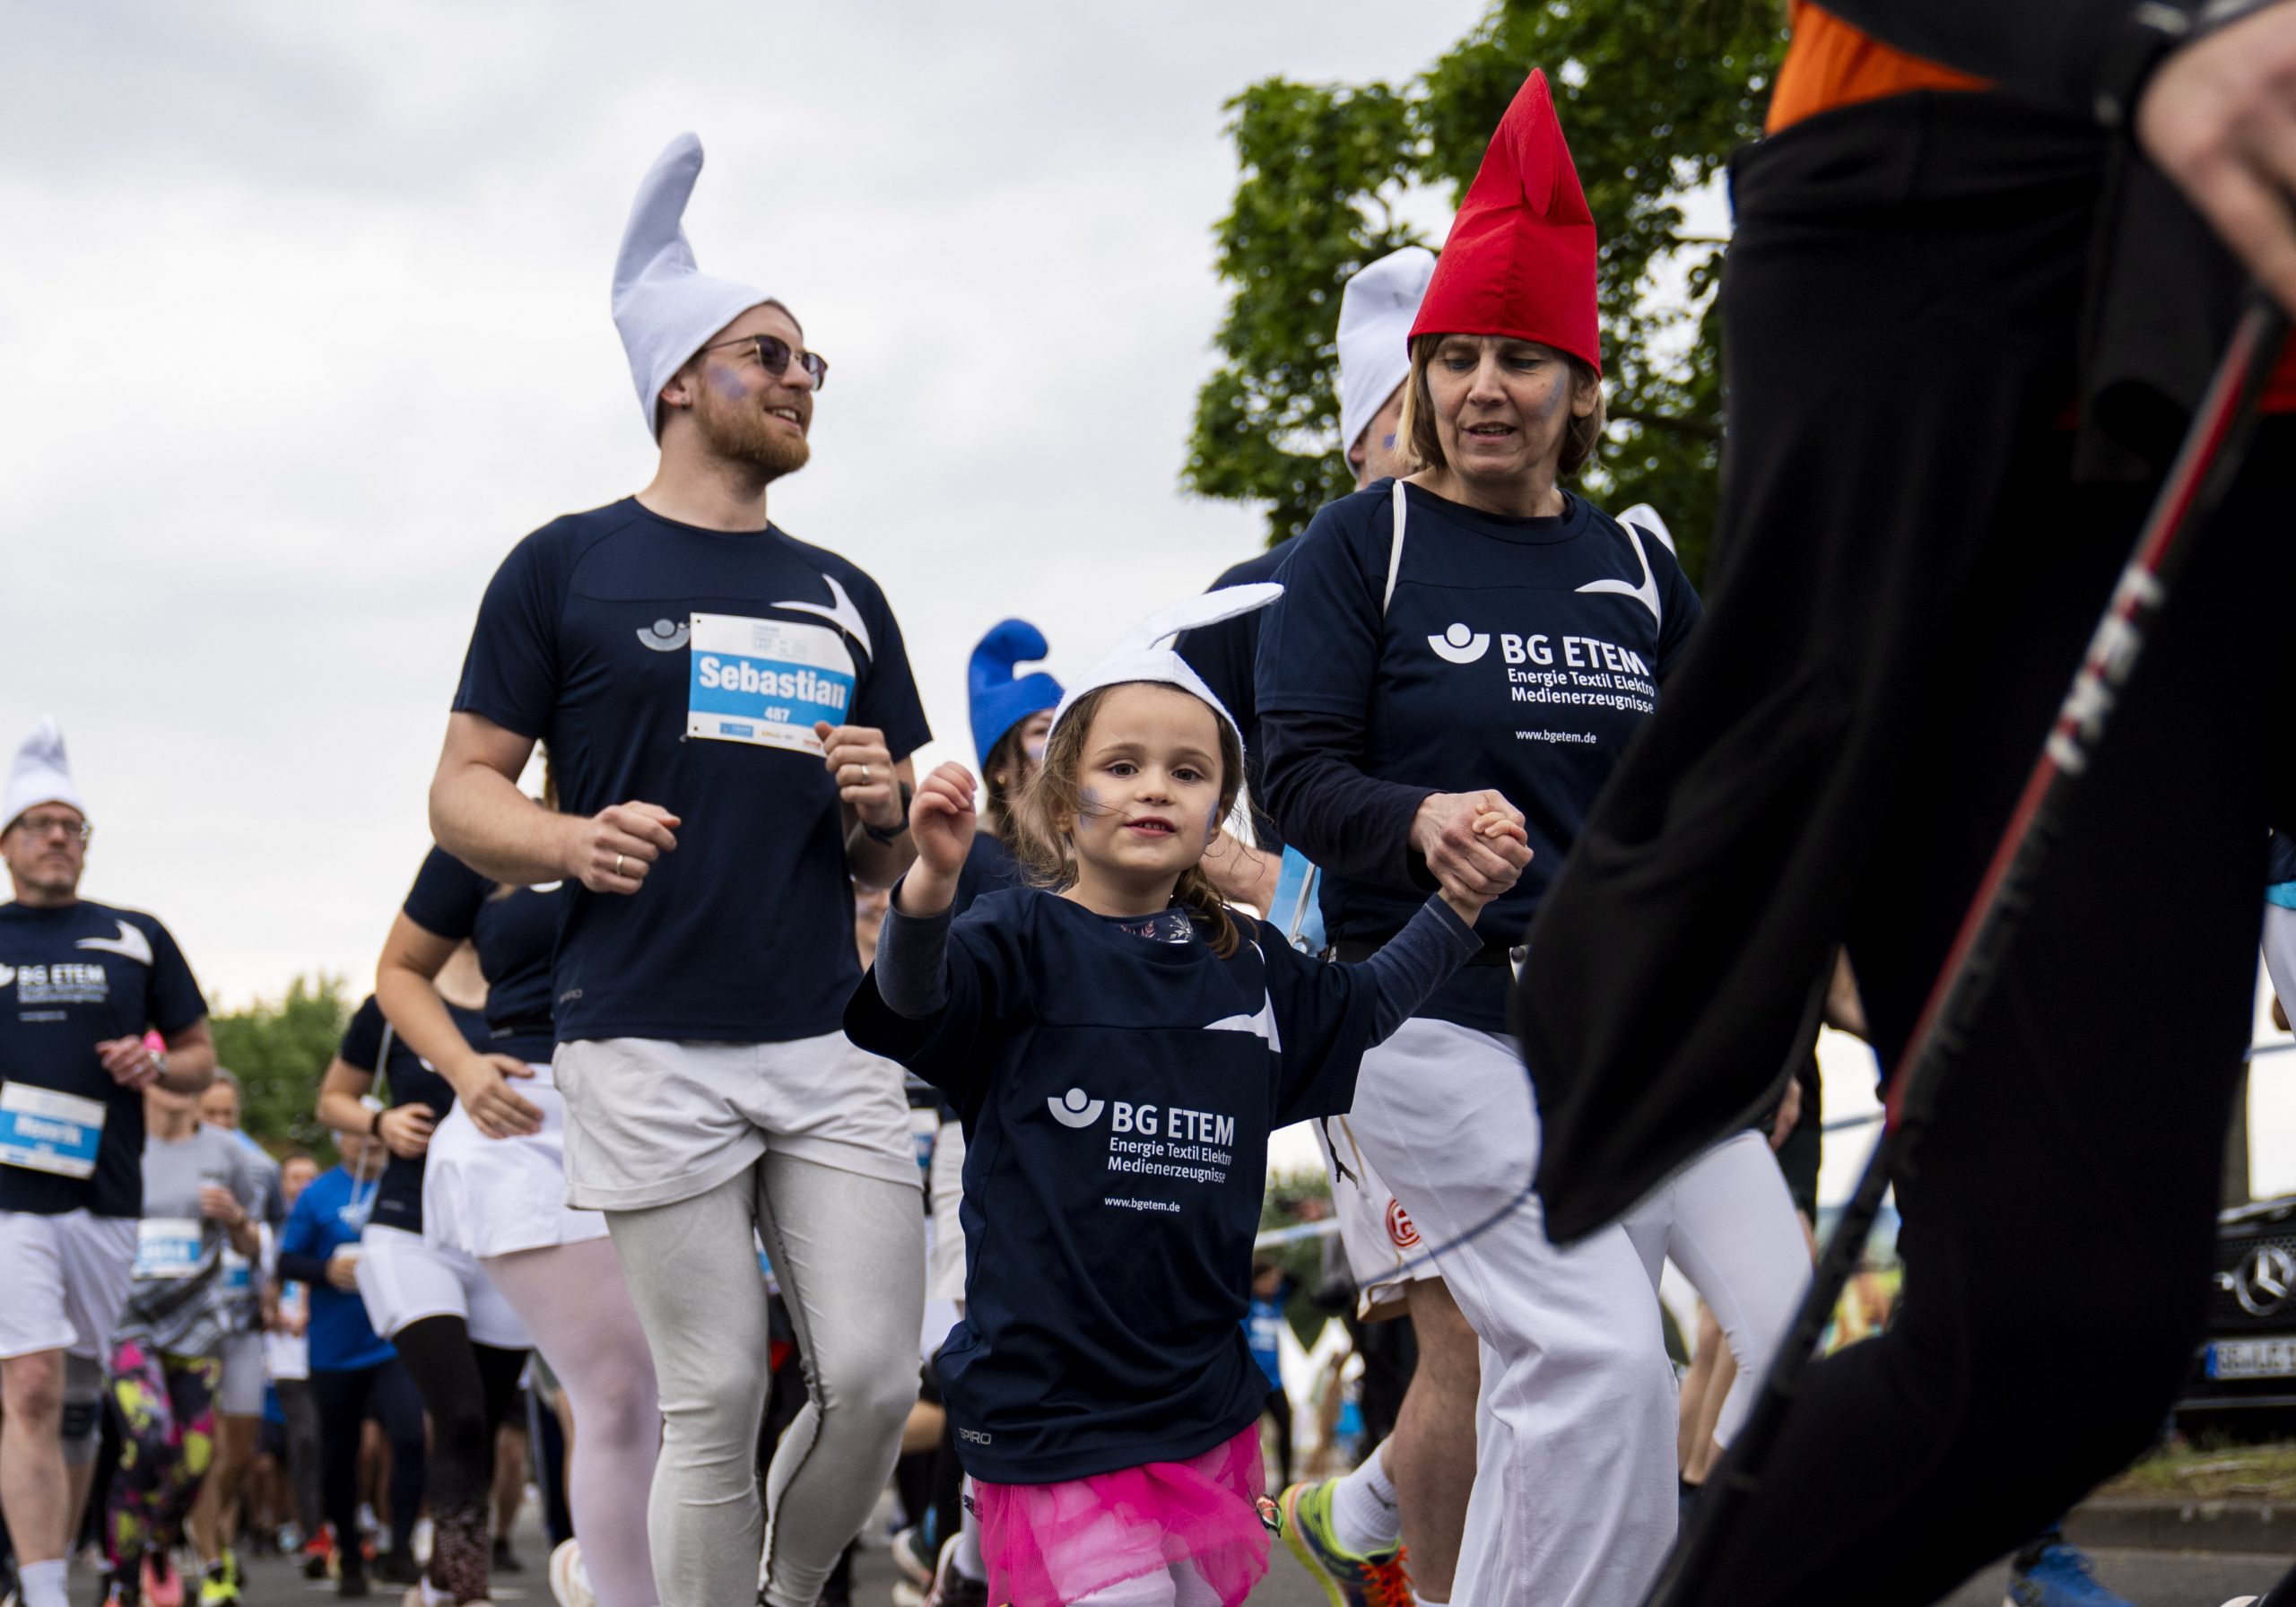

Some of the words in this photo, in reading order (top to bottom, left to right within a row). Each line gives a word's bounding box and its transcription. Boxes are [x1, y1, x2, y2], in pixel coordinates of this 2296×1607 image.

[1500, 633, 1553, 665] BG
[1562, 636, 1650, 677] ETEM
[699, 656, 847, 710] Sebastian
[1508, 668, 1568, 687] Energie
[1569, 671, 1613, 689] Textil
[1613, 675, 1655, 698] Elektro
[1511, 686, 1654, 715] Medienerzeugnisse
[1516, 729, 1596, 744] www.bgetem.de
[1111, 1101, 1158, 1135] BG
[1168, 1108, 1235, 1147] ETEM
[1109, 1137, 1164, 1158] Energie
[1167, 1142, 1200, 1161] Textil
[1202, 1147, 1232, 1167] Elektro
[1108, 1156, 1226, 1184] Medienerzeugnisse
[1104, 1196, 1181, 1212] www.bgetem.de
[959, 1427, 992, 1446] SPIRO
